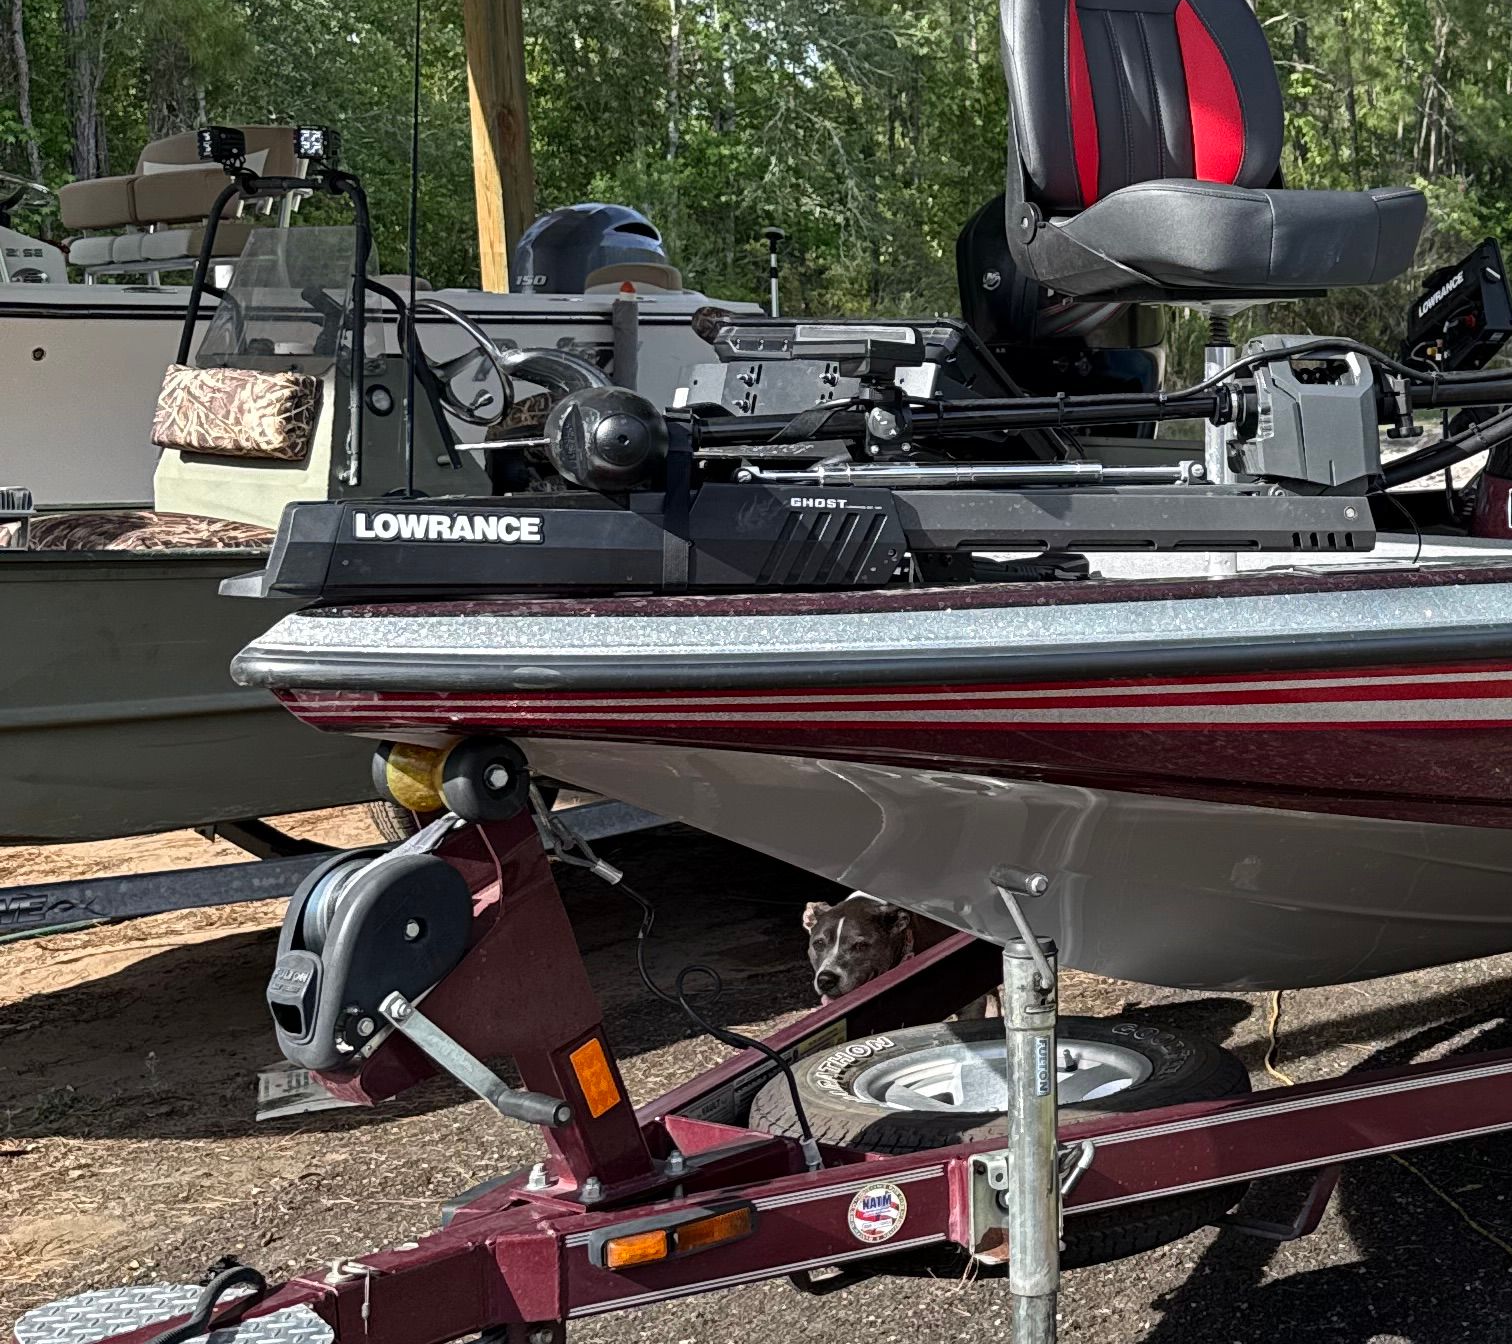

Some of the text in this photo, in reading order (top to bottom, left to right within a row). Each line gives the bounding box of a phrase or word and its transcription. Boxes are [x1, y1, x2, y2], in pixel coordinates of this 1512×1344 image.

[516, 275, 547, 285] 150
[1418, 270, 1464, 318] LOWRANCE
[790, 497, 847, 508] GHOST
[355, 512, 541, 542] LOWRANCE
[1038, 1039, 1048, 1092] FULTON
[862, 1193, 892, 1211] NATM
